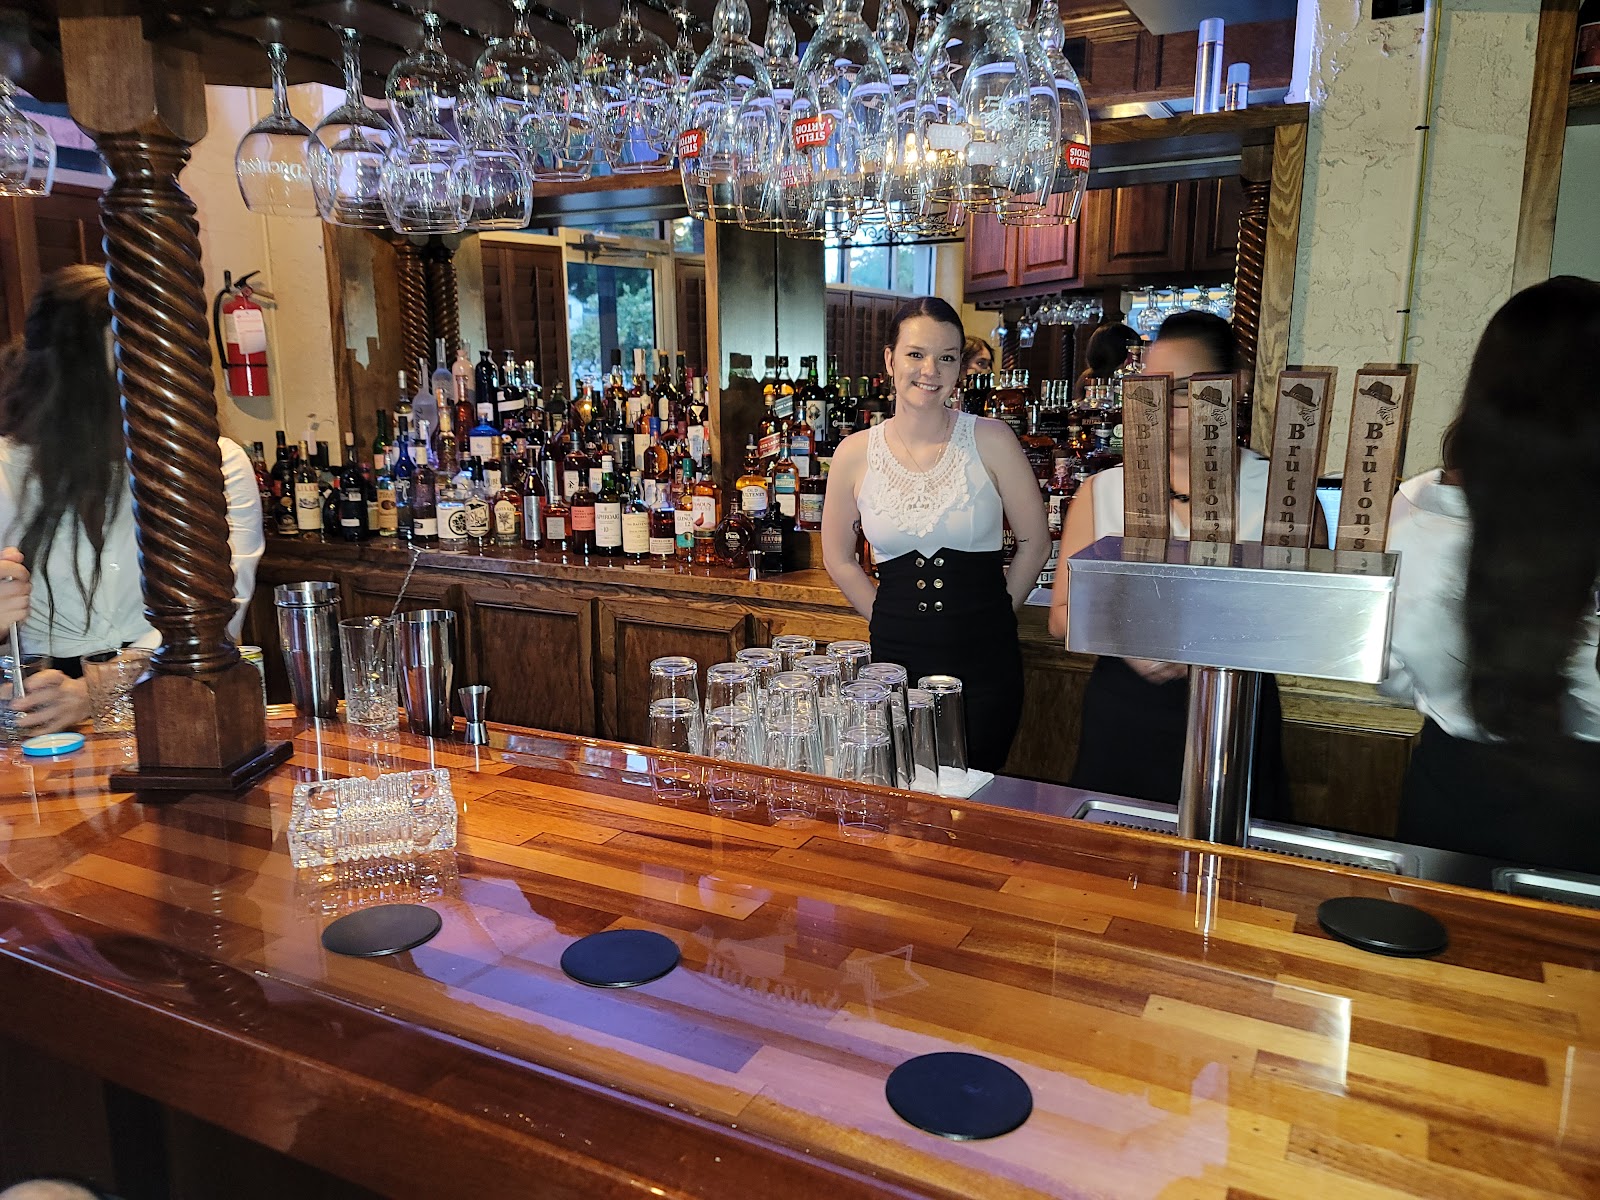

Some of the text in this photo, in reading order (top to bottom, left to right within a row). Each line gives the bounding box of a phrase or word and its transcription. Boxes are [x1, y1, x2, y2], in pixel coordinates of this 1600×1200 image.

[678, 133, 699, 148] ARTO
[795, 121, 826, 136] ARTOIS
[795, 130, 826, 145] STELLA
[1202, 423, 1220, 543] Bruton's
[1278, 422, 1306, 547] Bruton's
[1352, 422, 1384, 550] Bruton's
